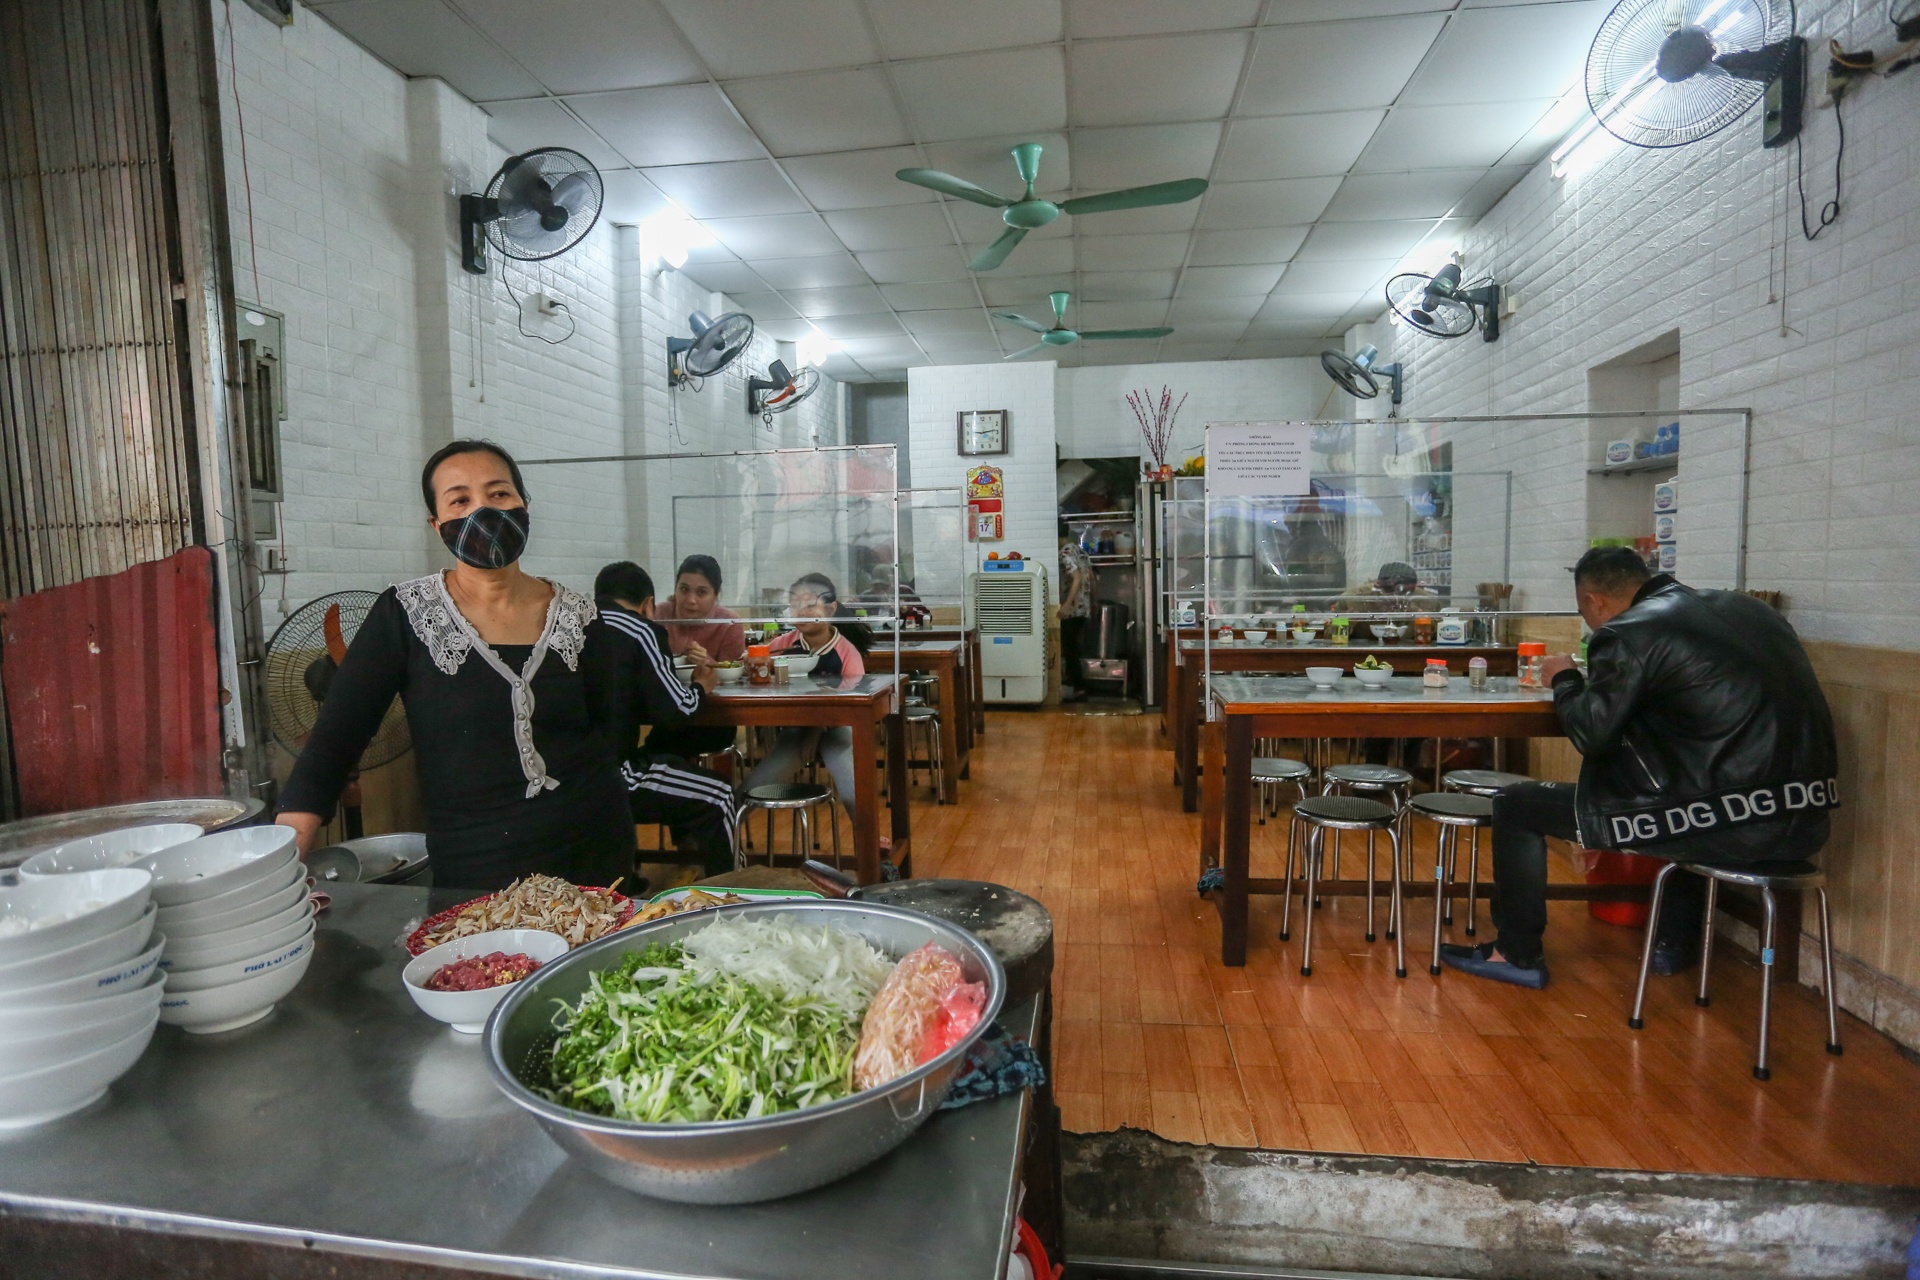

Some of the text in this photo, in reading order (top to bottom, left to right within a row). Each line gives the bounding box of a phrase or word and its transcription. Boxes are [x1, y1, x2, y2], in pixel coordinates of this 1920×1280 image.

[979, 523, 990, 532] 17
[1611, 813, 1659, 843] DG
[1665, 802, 1717, 835] DG
[1721, 789, 1777, 822] DG
[1784, 780, 1826, 809] DG
